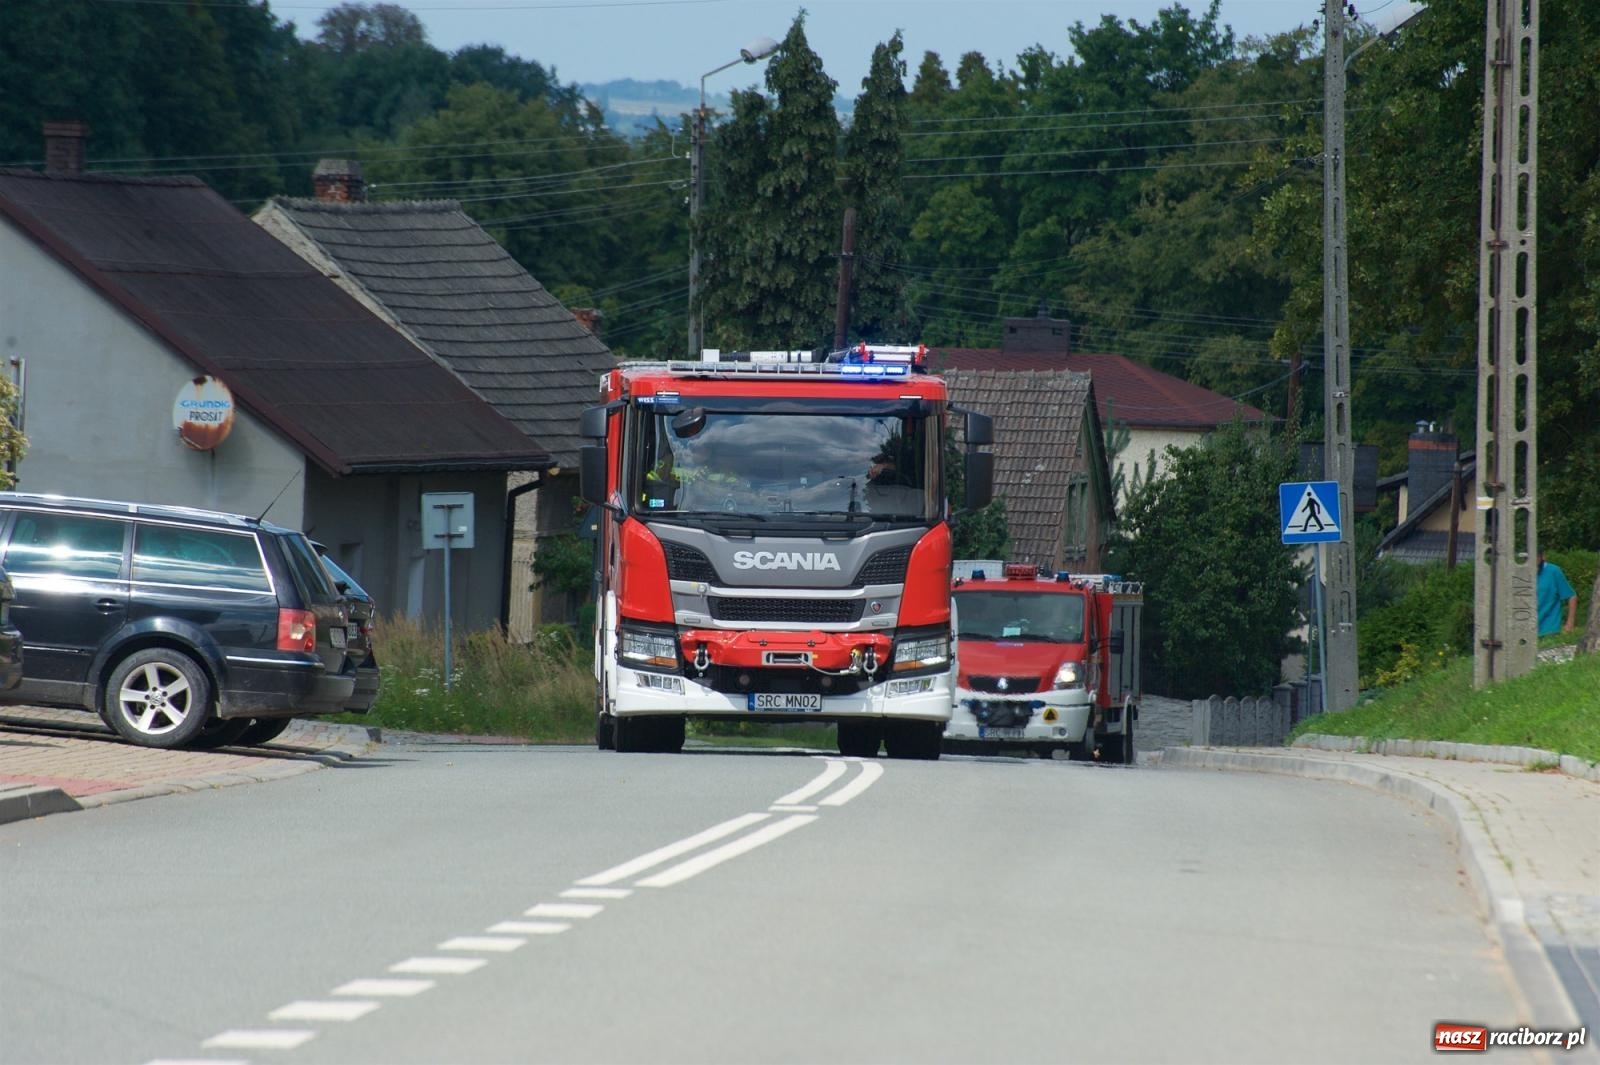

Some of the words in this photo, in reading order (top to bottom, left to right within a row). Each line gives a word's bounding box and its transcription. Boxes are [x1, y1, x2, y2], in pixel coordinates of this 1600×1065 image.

[732, 551, 841, 571] SCANIA
[757, 694, 781, 707] SRC
[785, 695, 817, 707] MN02
